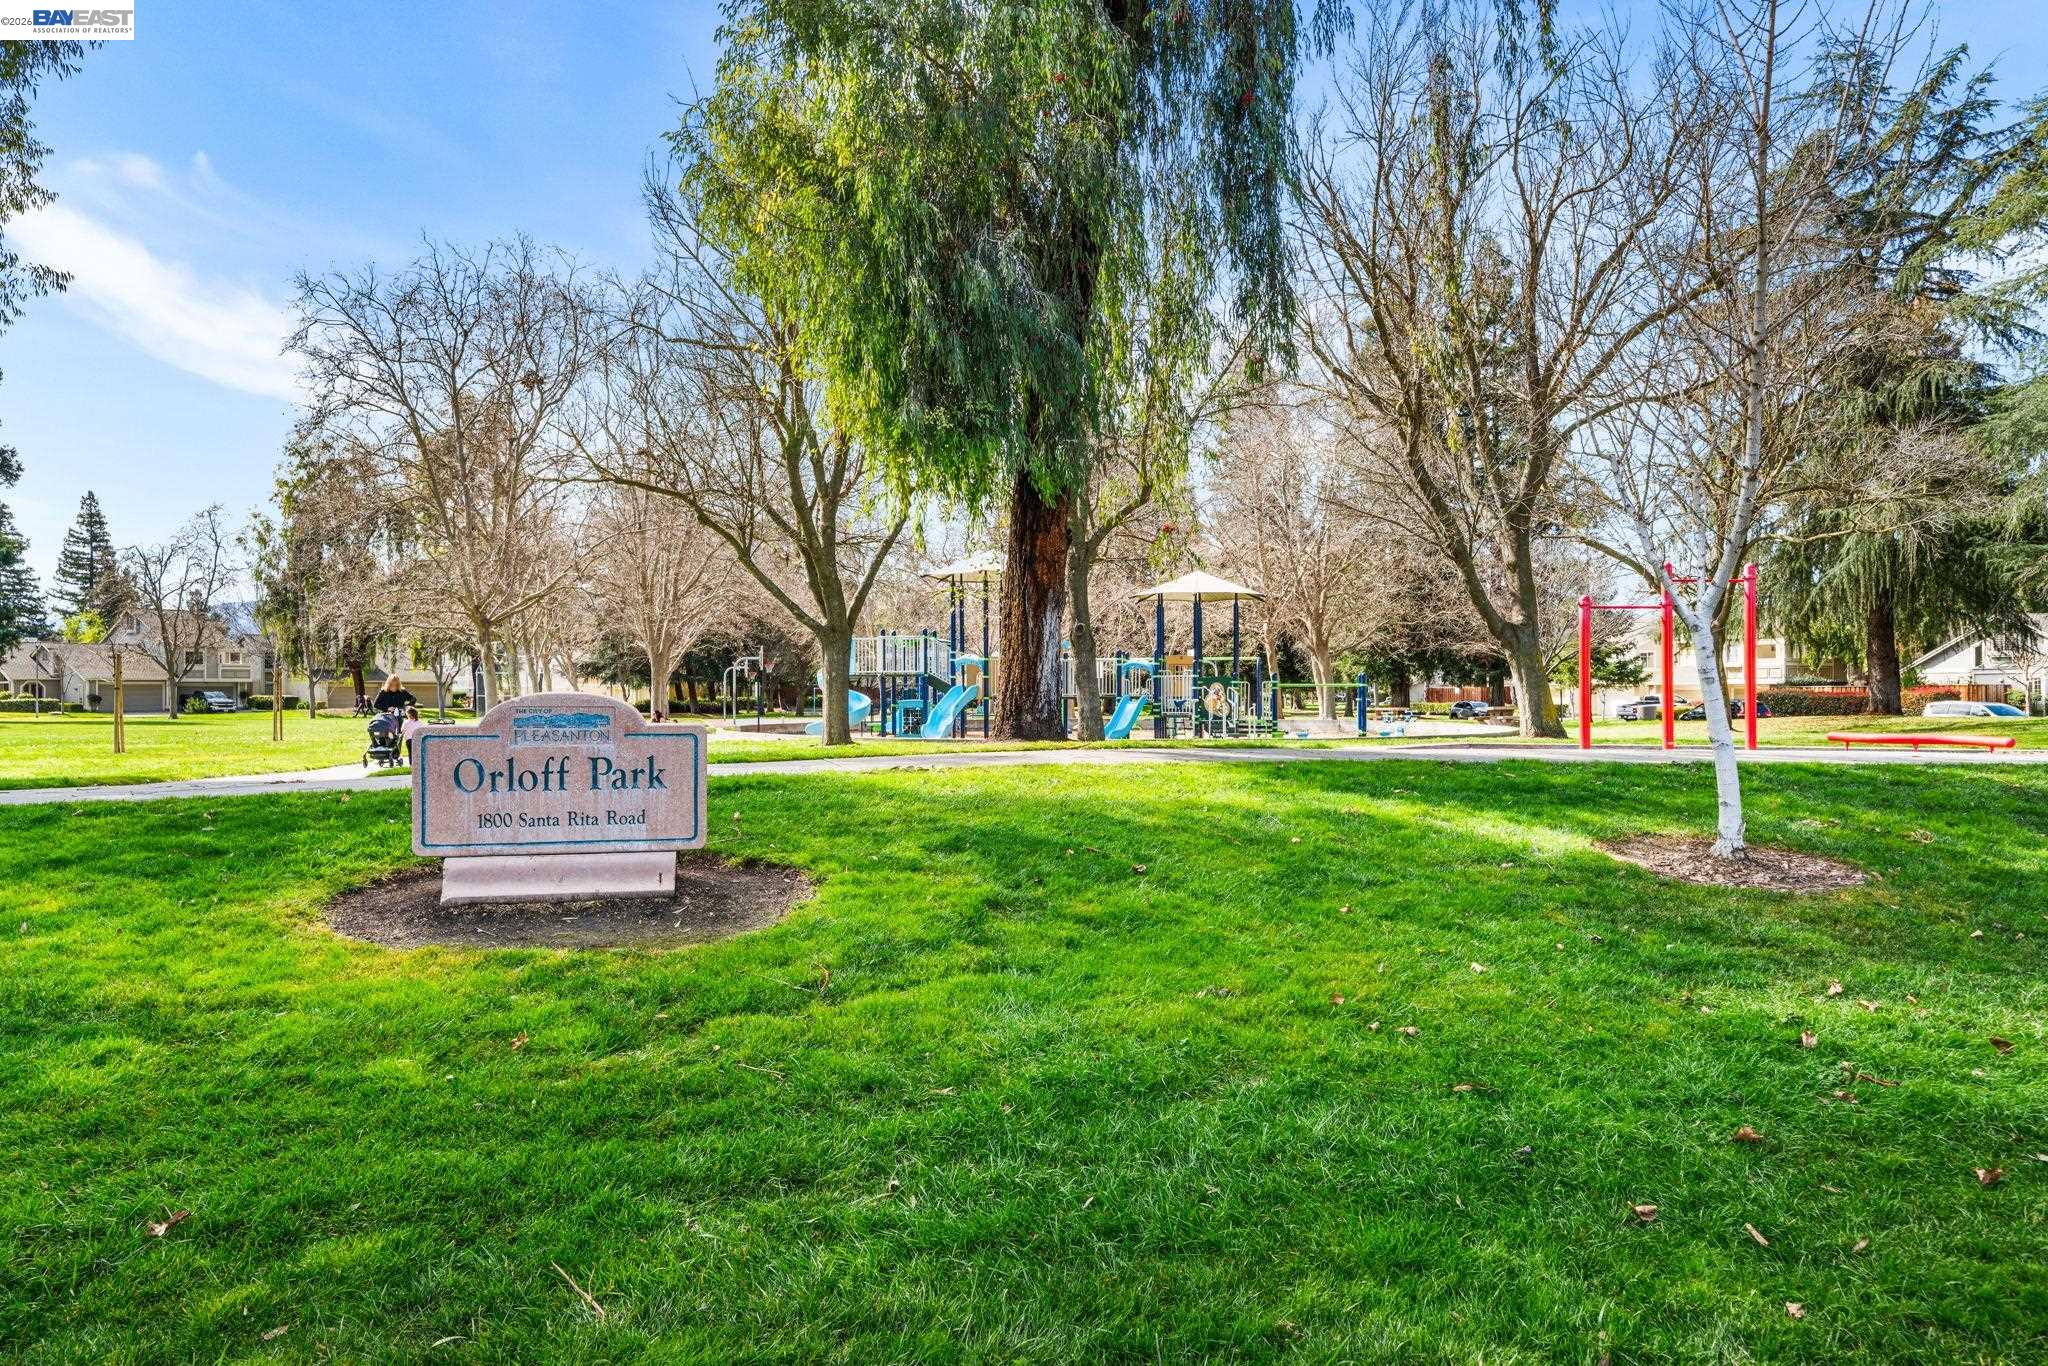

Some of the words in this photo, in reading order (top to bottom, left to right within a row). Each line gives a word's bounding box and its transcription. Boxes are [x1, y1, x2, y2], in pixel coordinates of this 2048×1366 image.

[514, 729, 610, 744] PLEASANTON
[453, 755, 570, 793] Orloff
[588, 755, 668, 791] Park
[477, 813, 513, 829] 1800
[518, 812, 560, 827] Santa
[567, 811, 599, 826] Rita
[606, 809, 646, 825] Road
